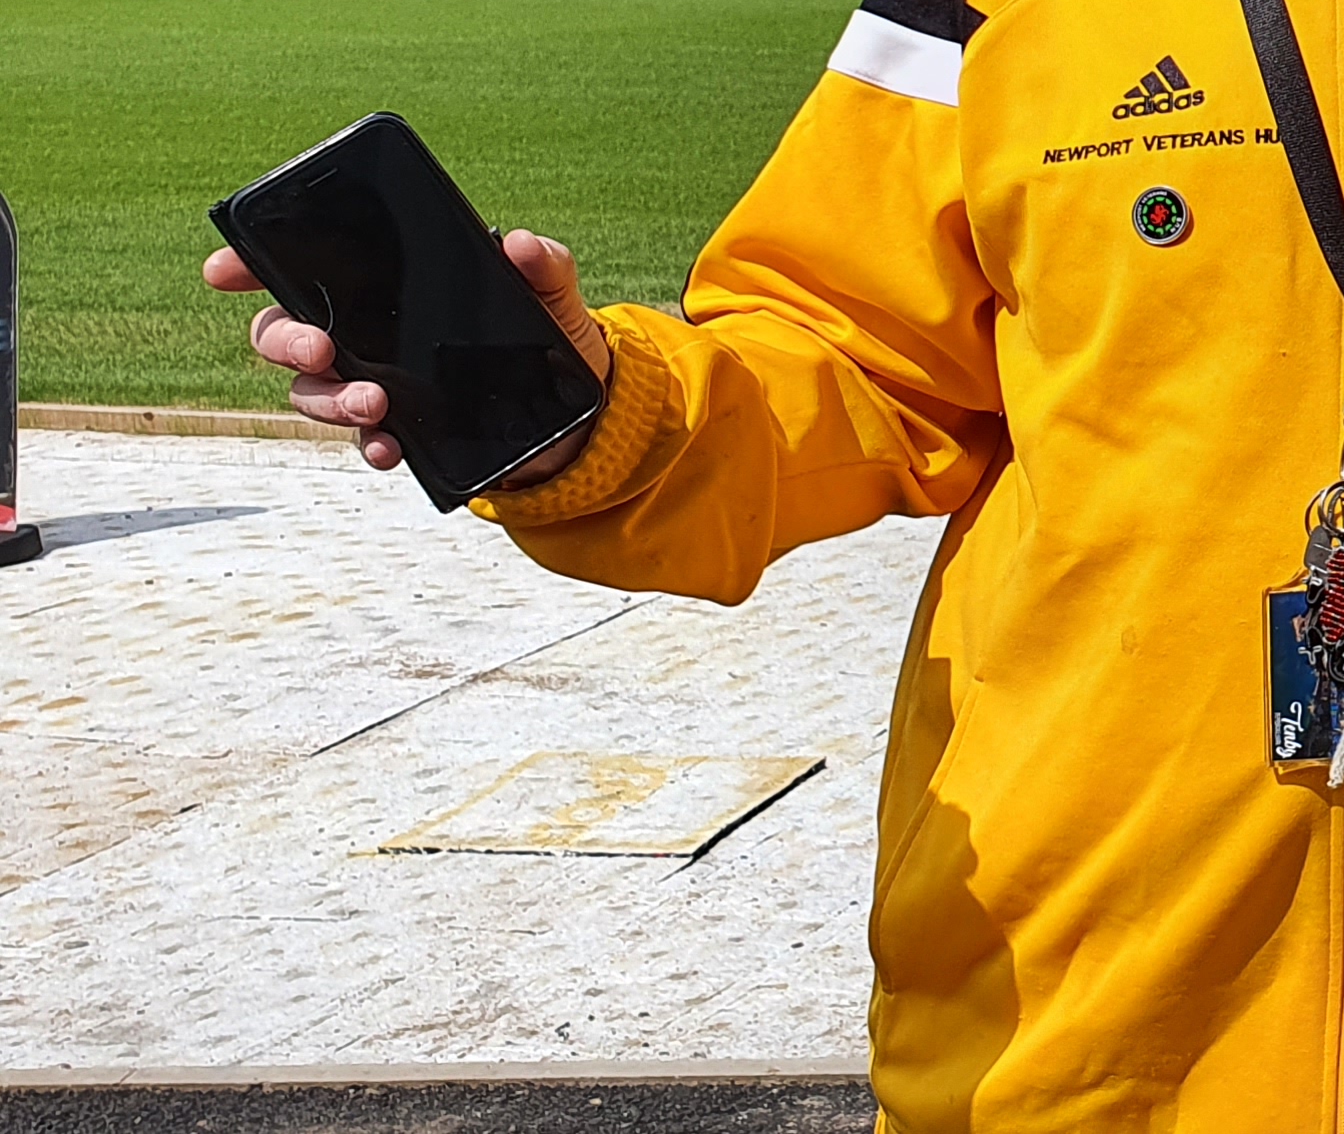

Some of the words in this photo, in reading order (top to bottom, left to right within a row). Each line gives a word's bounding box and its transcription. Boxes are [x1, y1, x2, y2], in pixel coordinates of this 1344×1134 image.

[1112, 89, 1205, 120] adidas
[1042, 138, 1134, 165] NEWPORT
[1142, 128, 1246, 152] VETERANS
[1254, 127, 1282, 145] HU
[1276, 701, 1304, 758] Tenby
